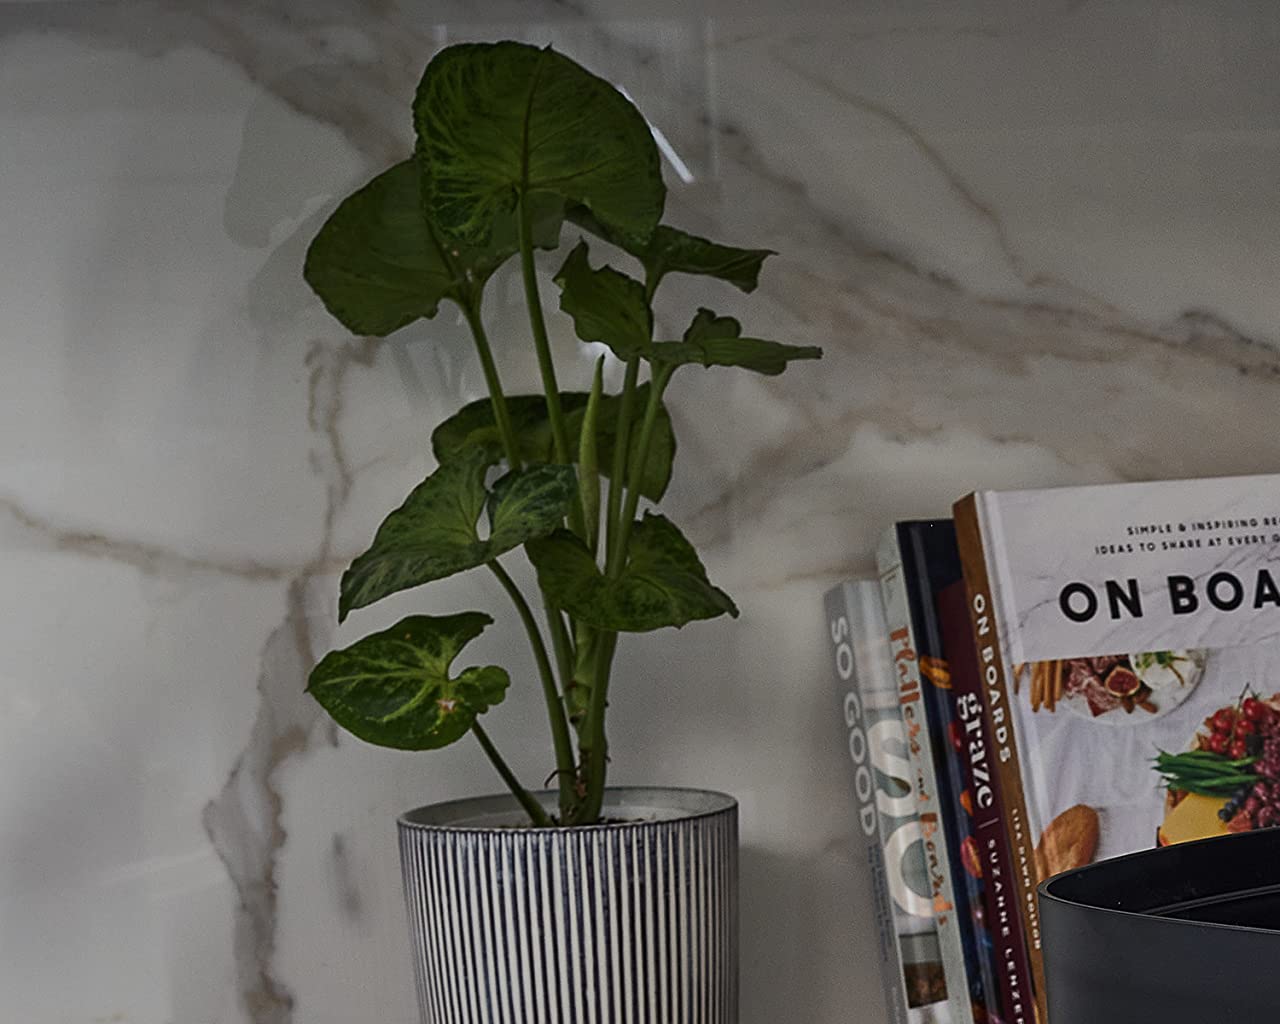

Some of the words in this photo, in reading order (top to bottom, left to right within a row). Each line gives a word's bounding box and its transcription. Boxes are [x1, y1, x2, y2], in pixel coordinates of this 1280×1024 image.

[1095, 543, 1133, 555] IDEAS
[1140, 542, 1156, 552] TO
[1161, 539, 1201, 550] SHARE
[1208, 537, 1221, 546] AT
[1228, 535, 1266, 546] EVERY
[1126, 523, 1172, 536] SIMPLE
[1178, 522, 1187, 533] &
[1191, 517, 1258, 531] INSPIRING
[1058, 578, 1143, 623] ON
[973, 593, 990, 636] ON
[982, 646, 1012, 763] BOARDS
[831, 616, 853, 681] SO
[844, 692, 876, 837] GOOD
[957, 692, 993, 810] graze
[987, 838, 1011, 937] SUZANNE
[1011, 808, 1023, 840] LISA
[920, 812, 953, 927] Boards
